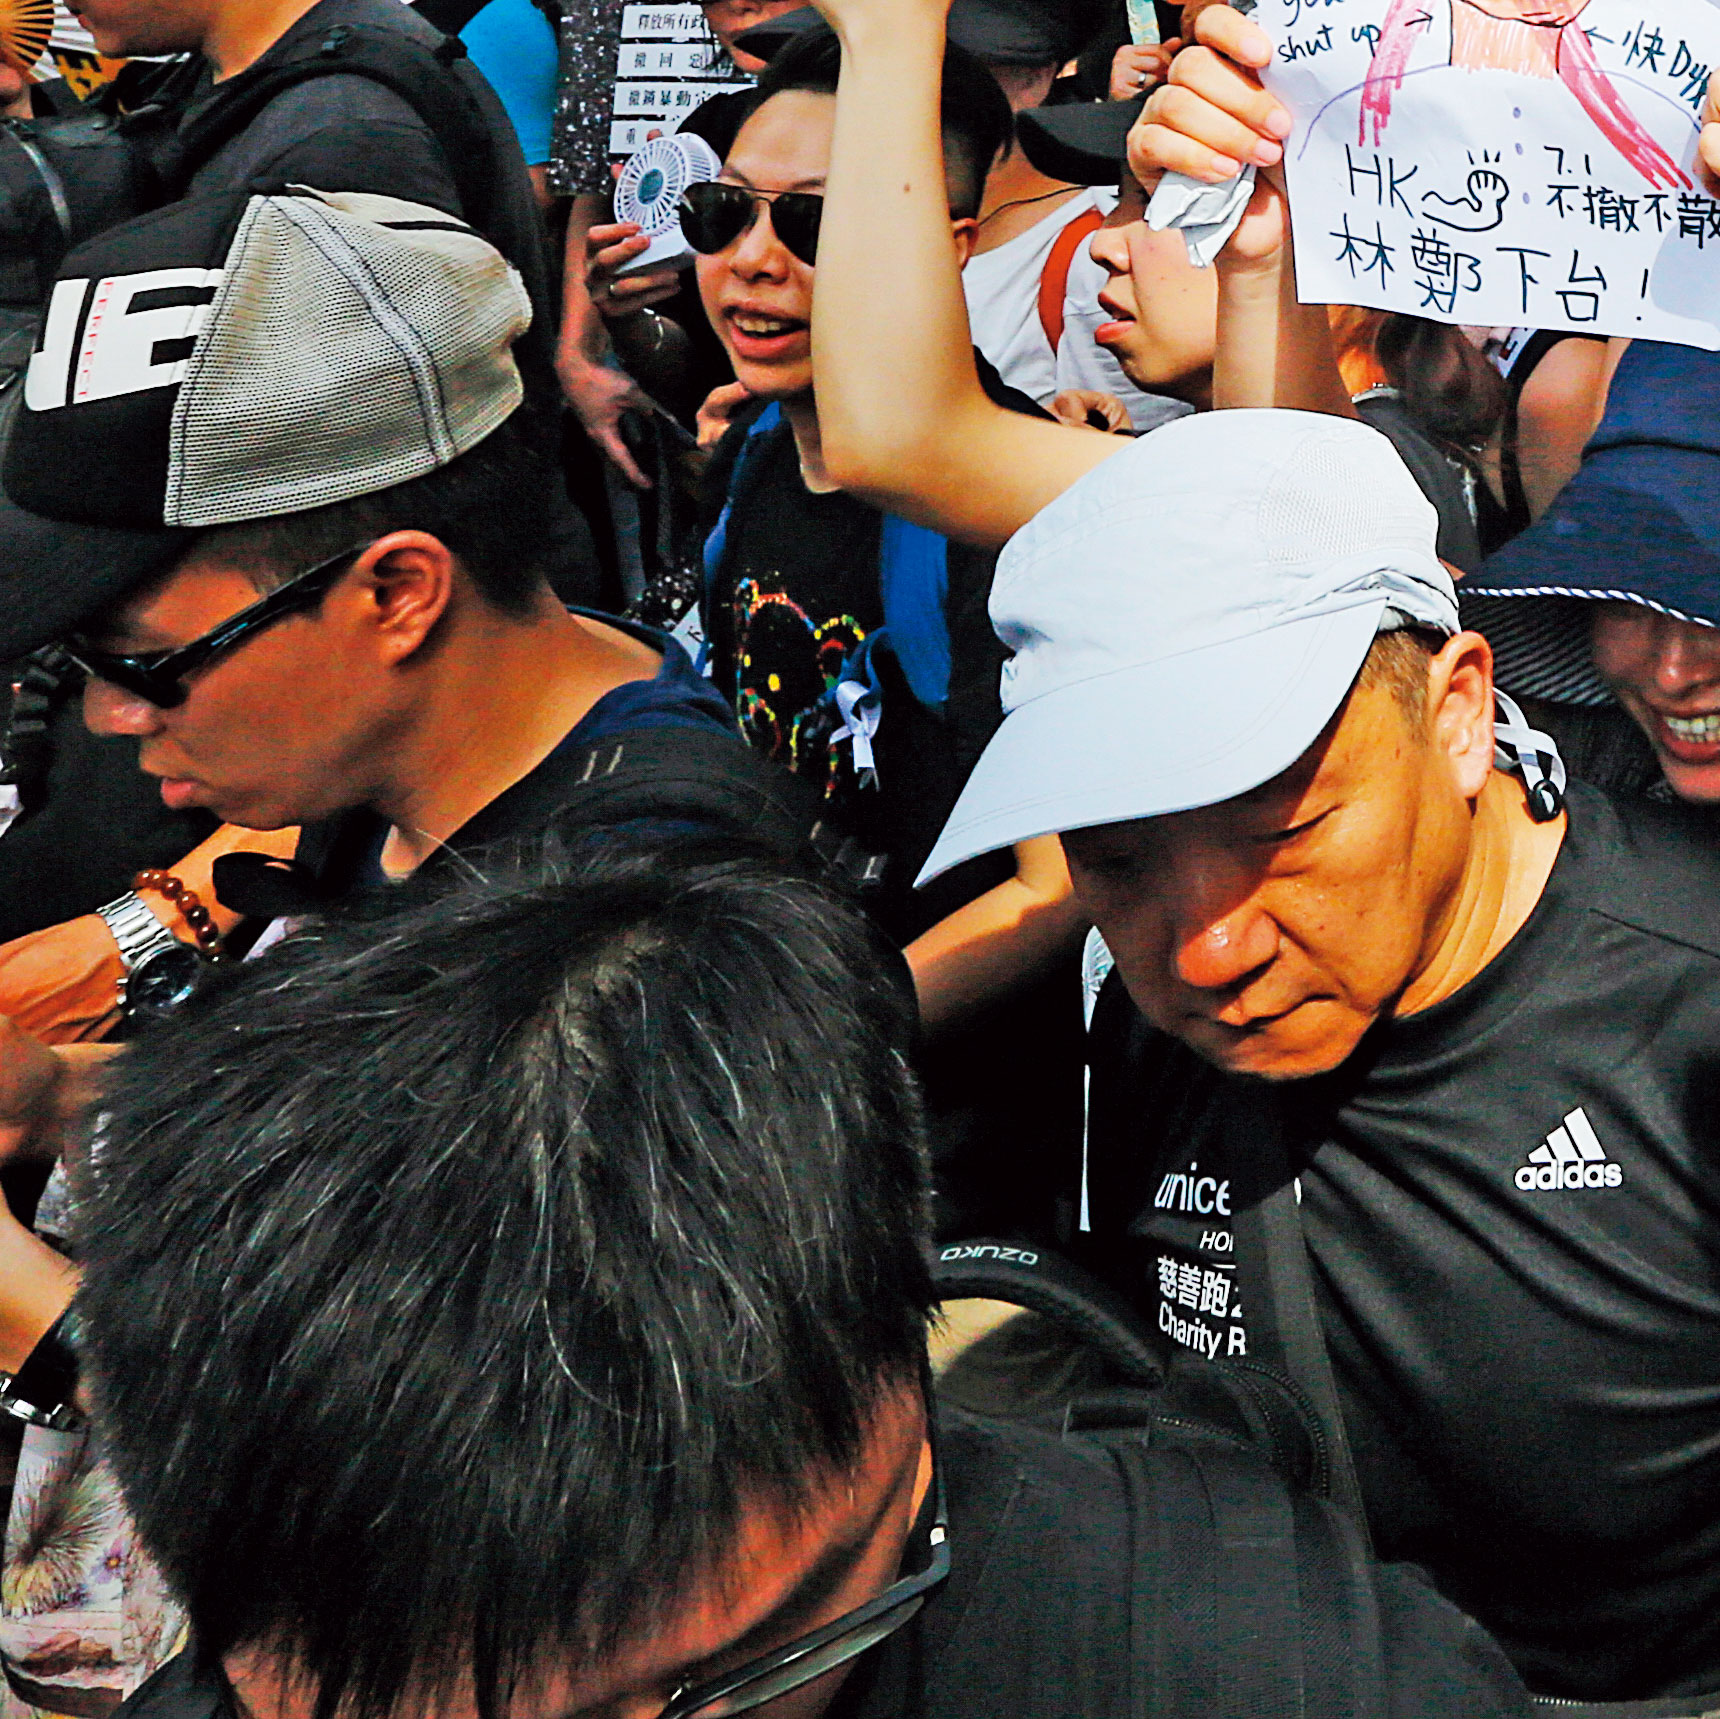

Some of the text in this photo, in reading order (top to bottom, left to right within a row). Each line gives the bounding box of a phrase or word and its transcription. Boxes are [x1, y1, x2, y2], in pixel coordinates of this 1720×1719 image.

[1278, 23, 1382, 66] shut up
[1344, 145, 1419, 216] HK
[1543, 145, 1593, 178] 7.1
[1329, 211, 1651, 326] 林鄭下台!
[1514, 1158, 1623, 1193] adidas
[1199, 1229, 1234, 1254] HO
[1156, 1255, 1230, 1319] 慈善跑
[1157, 1304, 1224, 1361] Charity
